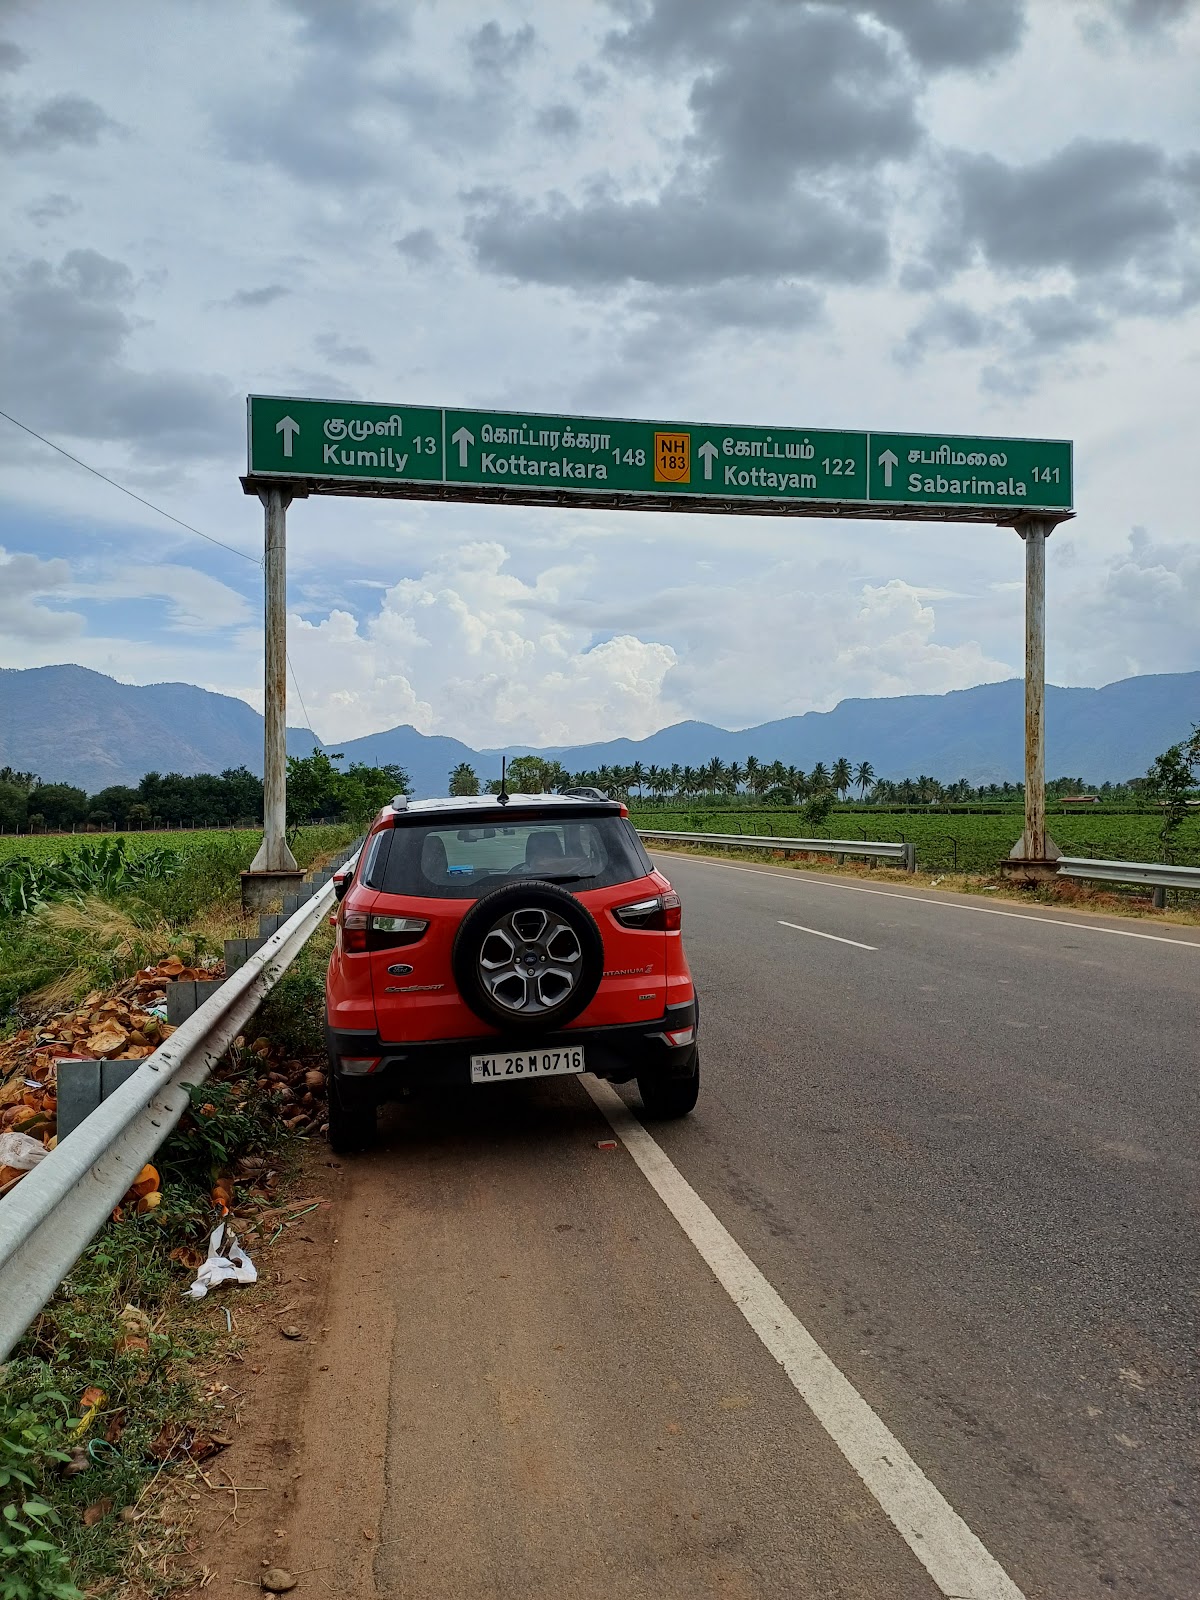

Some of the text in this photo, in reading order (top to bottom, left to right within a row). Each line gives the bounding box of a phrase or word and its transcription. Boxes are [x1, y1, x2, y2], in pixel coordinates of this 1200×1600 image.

[323, 414, 402, 441] குமுளி
[481, 423, 611, 453] கொட்டாரக்கரா
[412, 435, 437, 455] 13
[661, 439, 685, 454] NH
[722, 436, 815, 459] கோட்டயம்
[907, 444, 1008, 467] சபரிமலை
[323, 443, 409, 472] Kumily
[481, 452, 608, 480] Kottarakara
[611, 447, 646, 467] 148
[660, 455, 686, 470] 183
[821, 457, 856, 476] 122
[724, 465, 817, 491] Kottayam
[907, 473, 1027, 497] Sabarimala
[1031, 466, 1061, 484] 141
[482, 1051, 581, 1077] KL 26 M 0716
